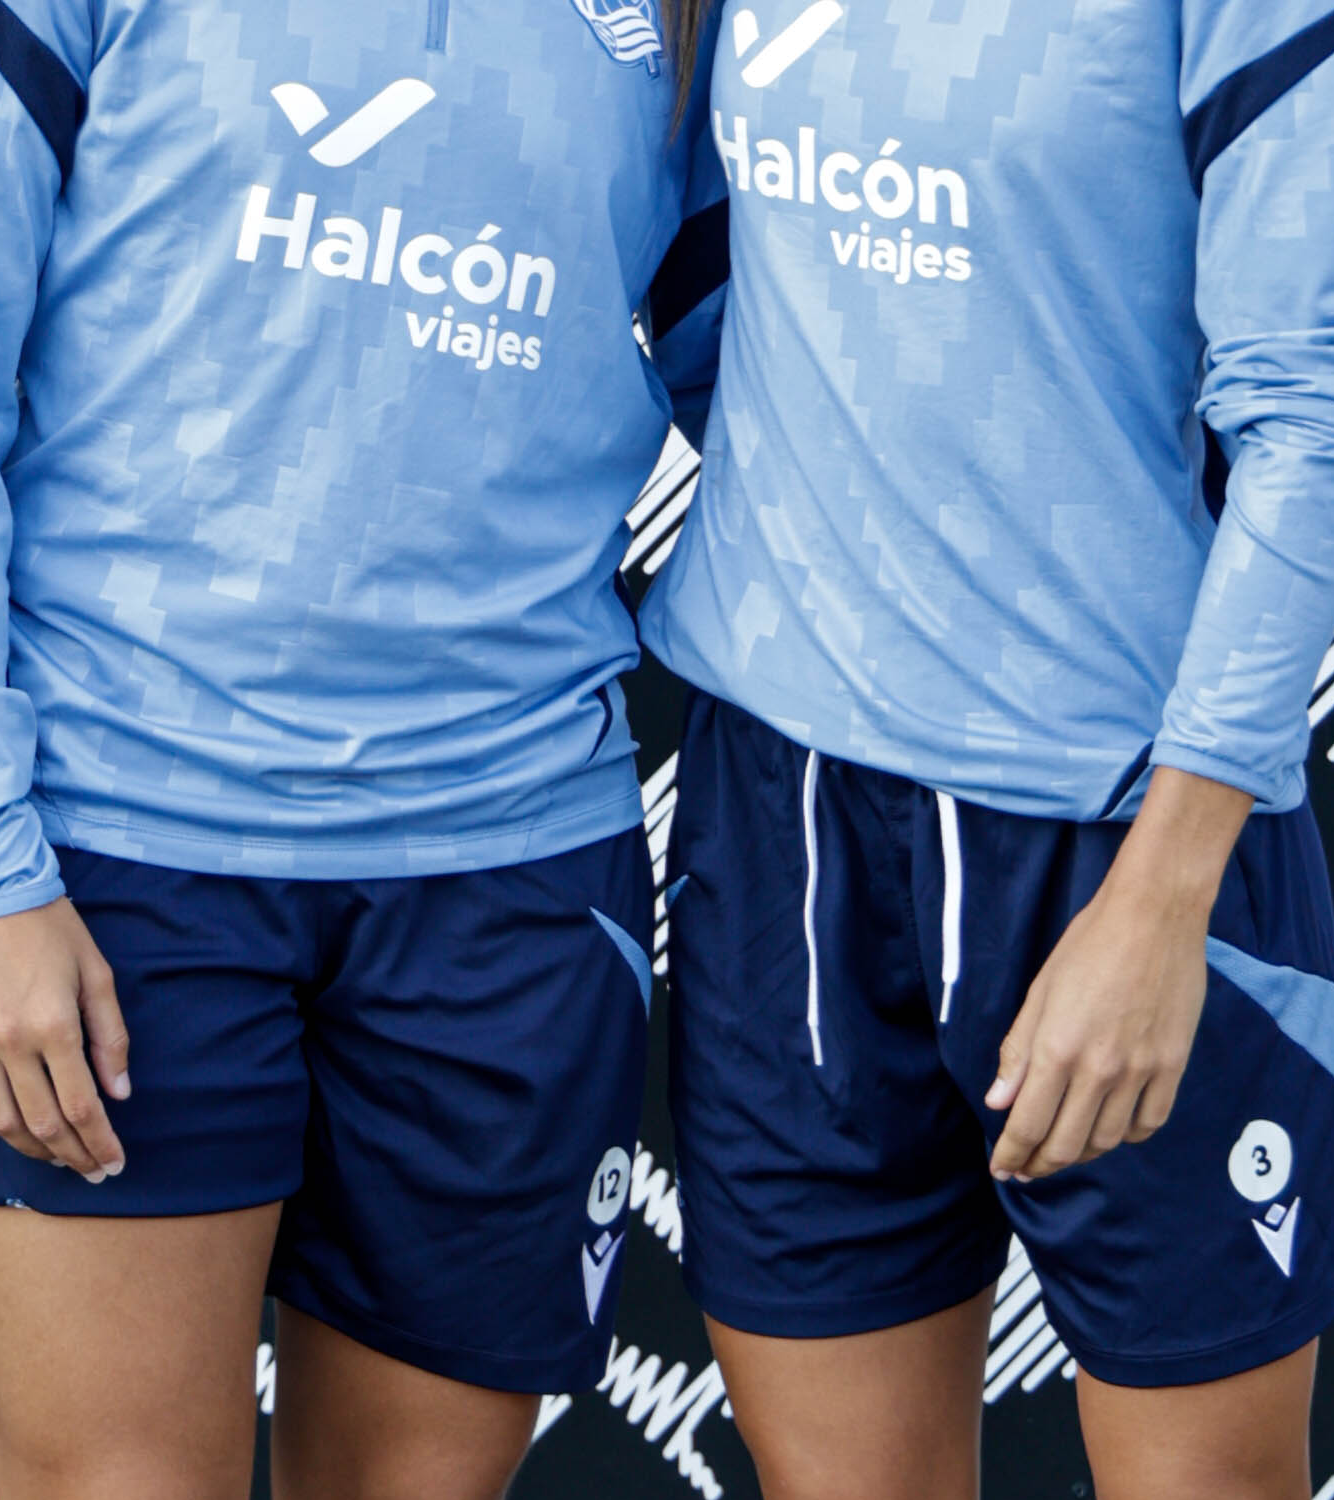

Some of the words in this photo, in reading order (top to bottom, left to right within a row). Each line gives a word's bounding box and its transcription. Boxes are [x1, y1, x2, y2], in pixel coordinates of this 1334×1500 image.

[714, 110, 969, 228] Halcón
[235, 183, 555, 316] Halcón
[829, 221, 972, 285] viajes
[405, 305, 541, 370] viajes
[598, 1168, 621, 1203] 12
[1251, 1145, 1272, 1176] 3
